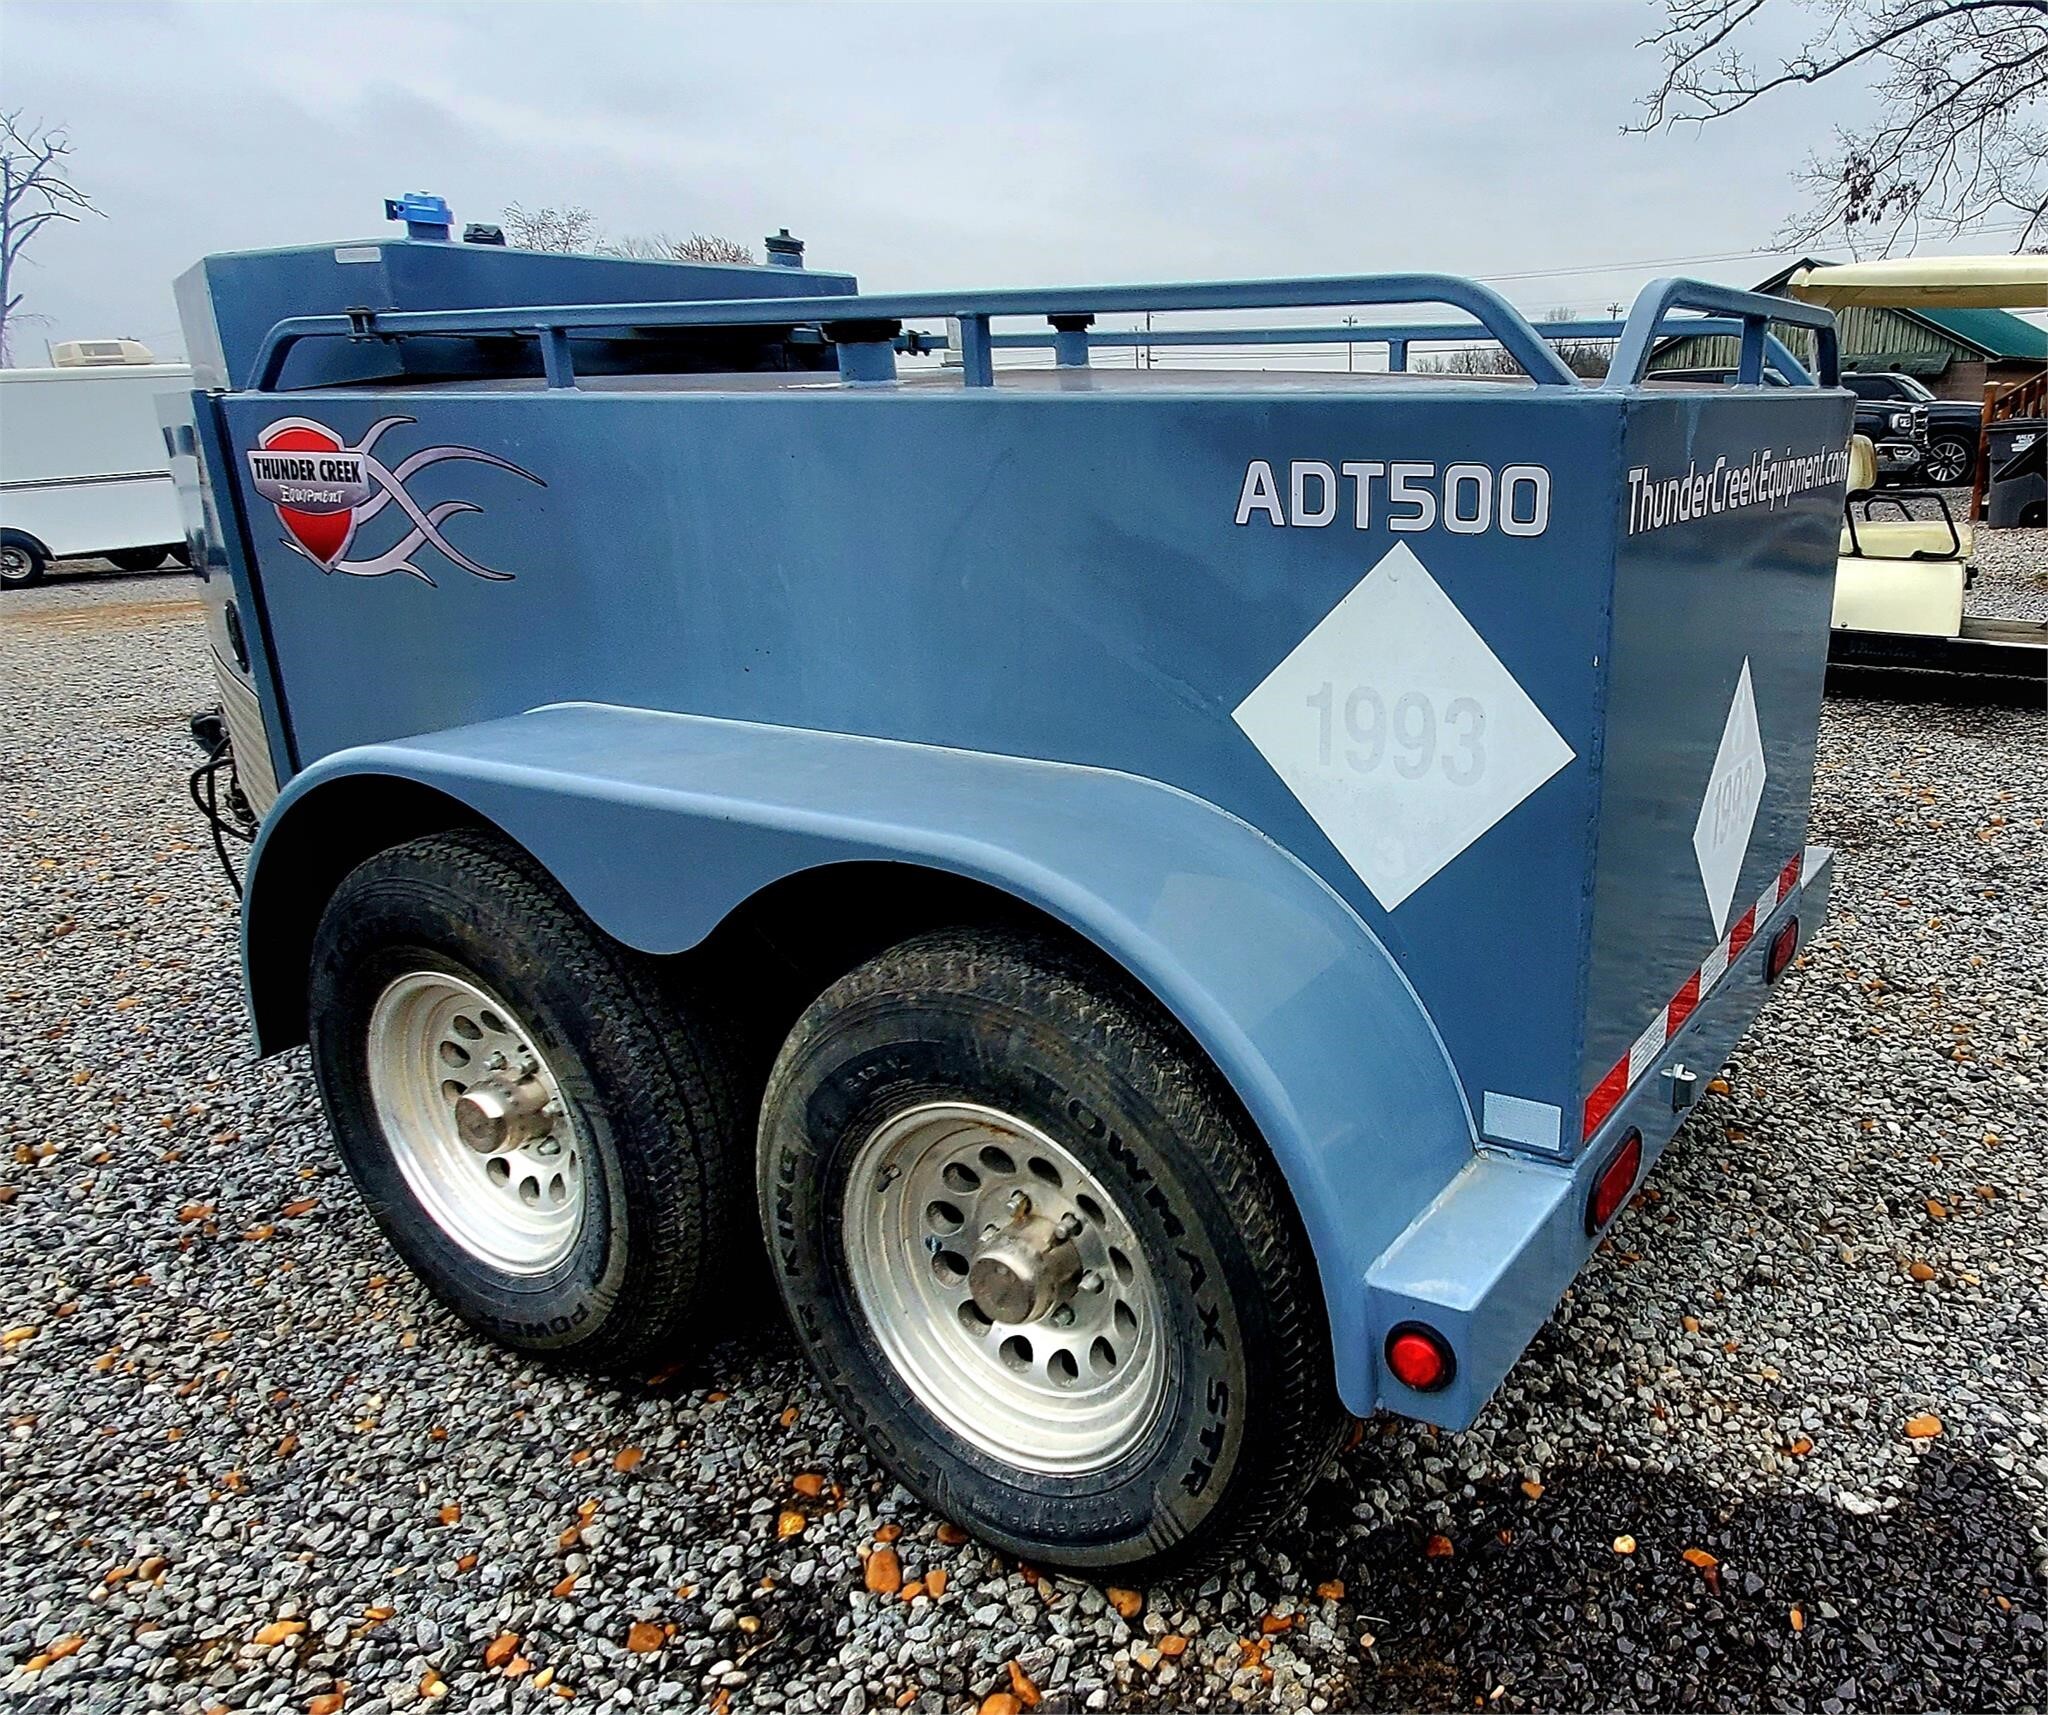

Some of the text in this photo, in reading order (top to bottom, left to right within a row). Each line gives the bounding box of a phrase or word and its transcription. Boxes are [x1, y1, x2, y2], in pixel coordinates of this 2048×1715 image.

[252, 457, 362, 484] THUNDER CREEK
[1234, 459, 1552, 537] ADT500
[1628, 445, 1849, 536] ThunderCreekEquipment.com
[1305, 681, 1488, 787] 1993
[776, 1145, 801, 1277] KING
[1180, 1376, 1229, 1497] STR
